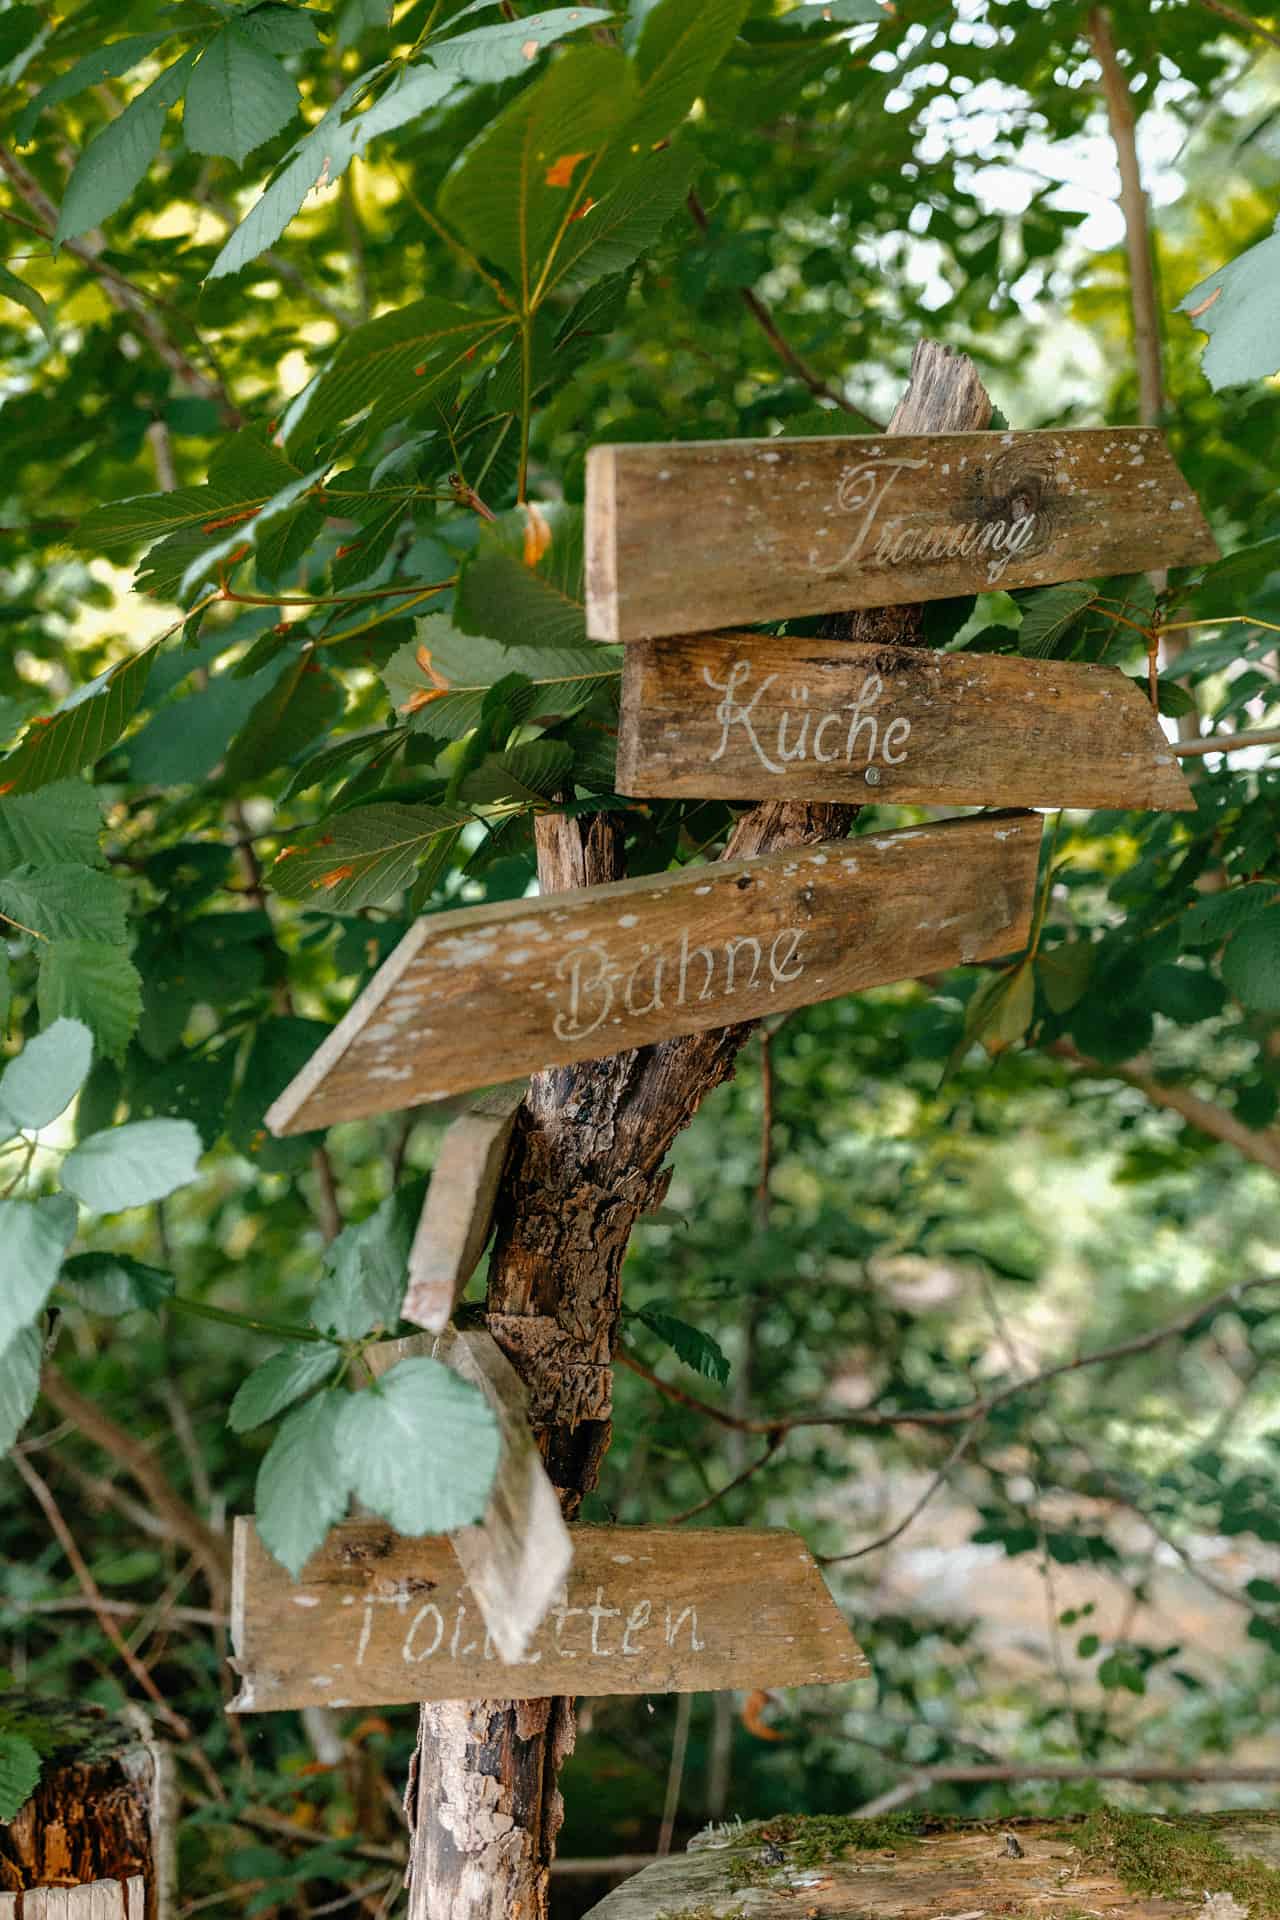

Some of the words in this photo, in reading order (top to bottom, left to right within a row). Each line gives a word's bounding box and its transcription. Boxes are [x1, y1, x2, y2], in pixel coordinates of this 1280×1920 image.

[703, 659, 911, 774] Küche
[553, 928, 808, 1042] Bühne
[343, 1586, 706, 1665] Toitten
